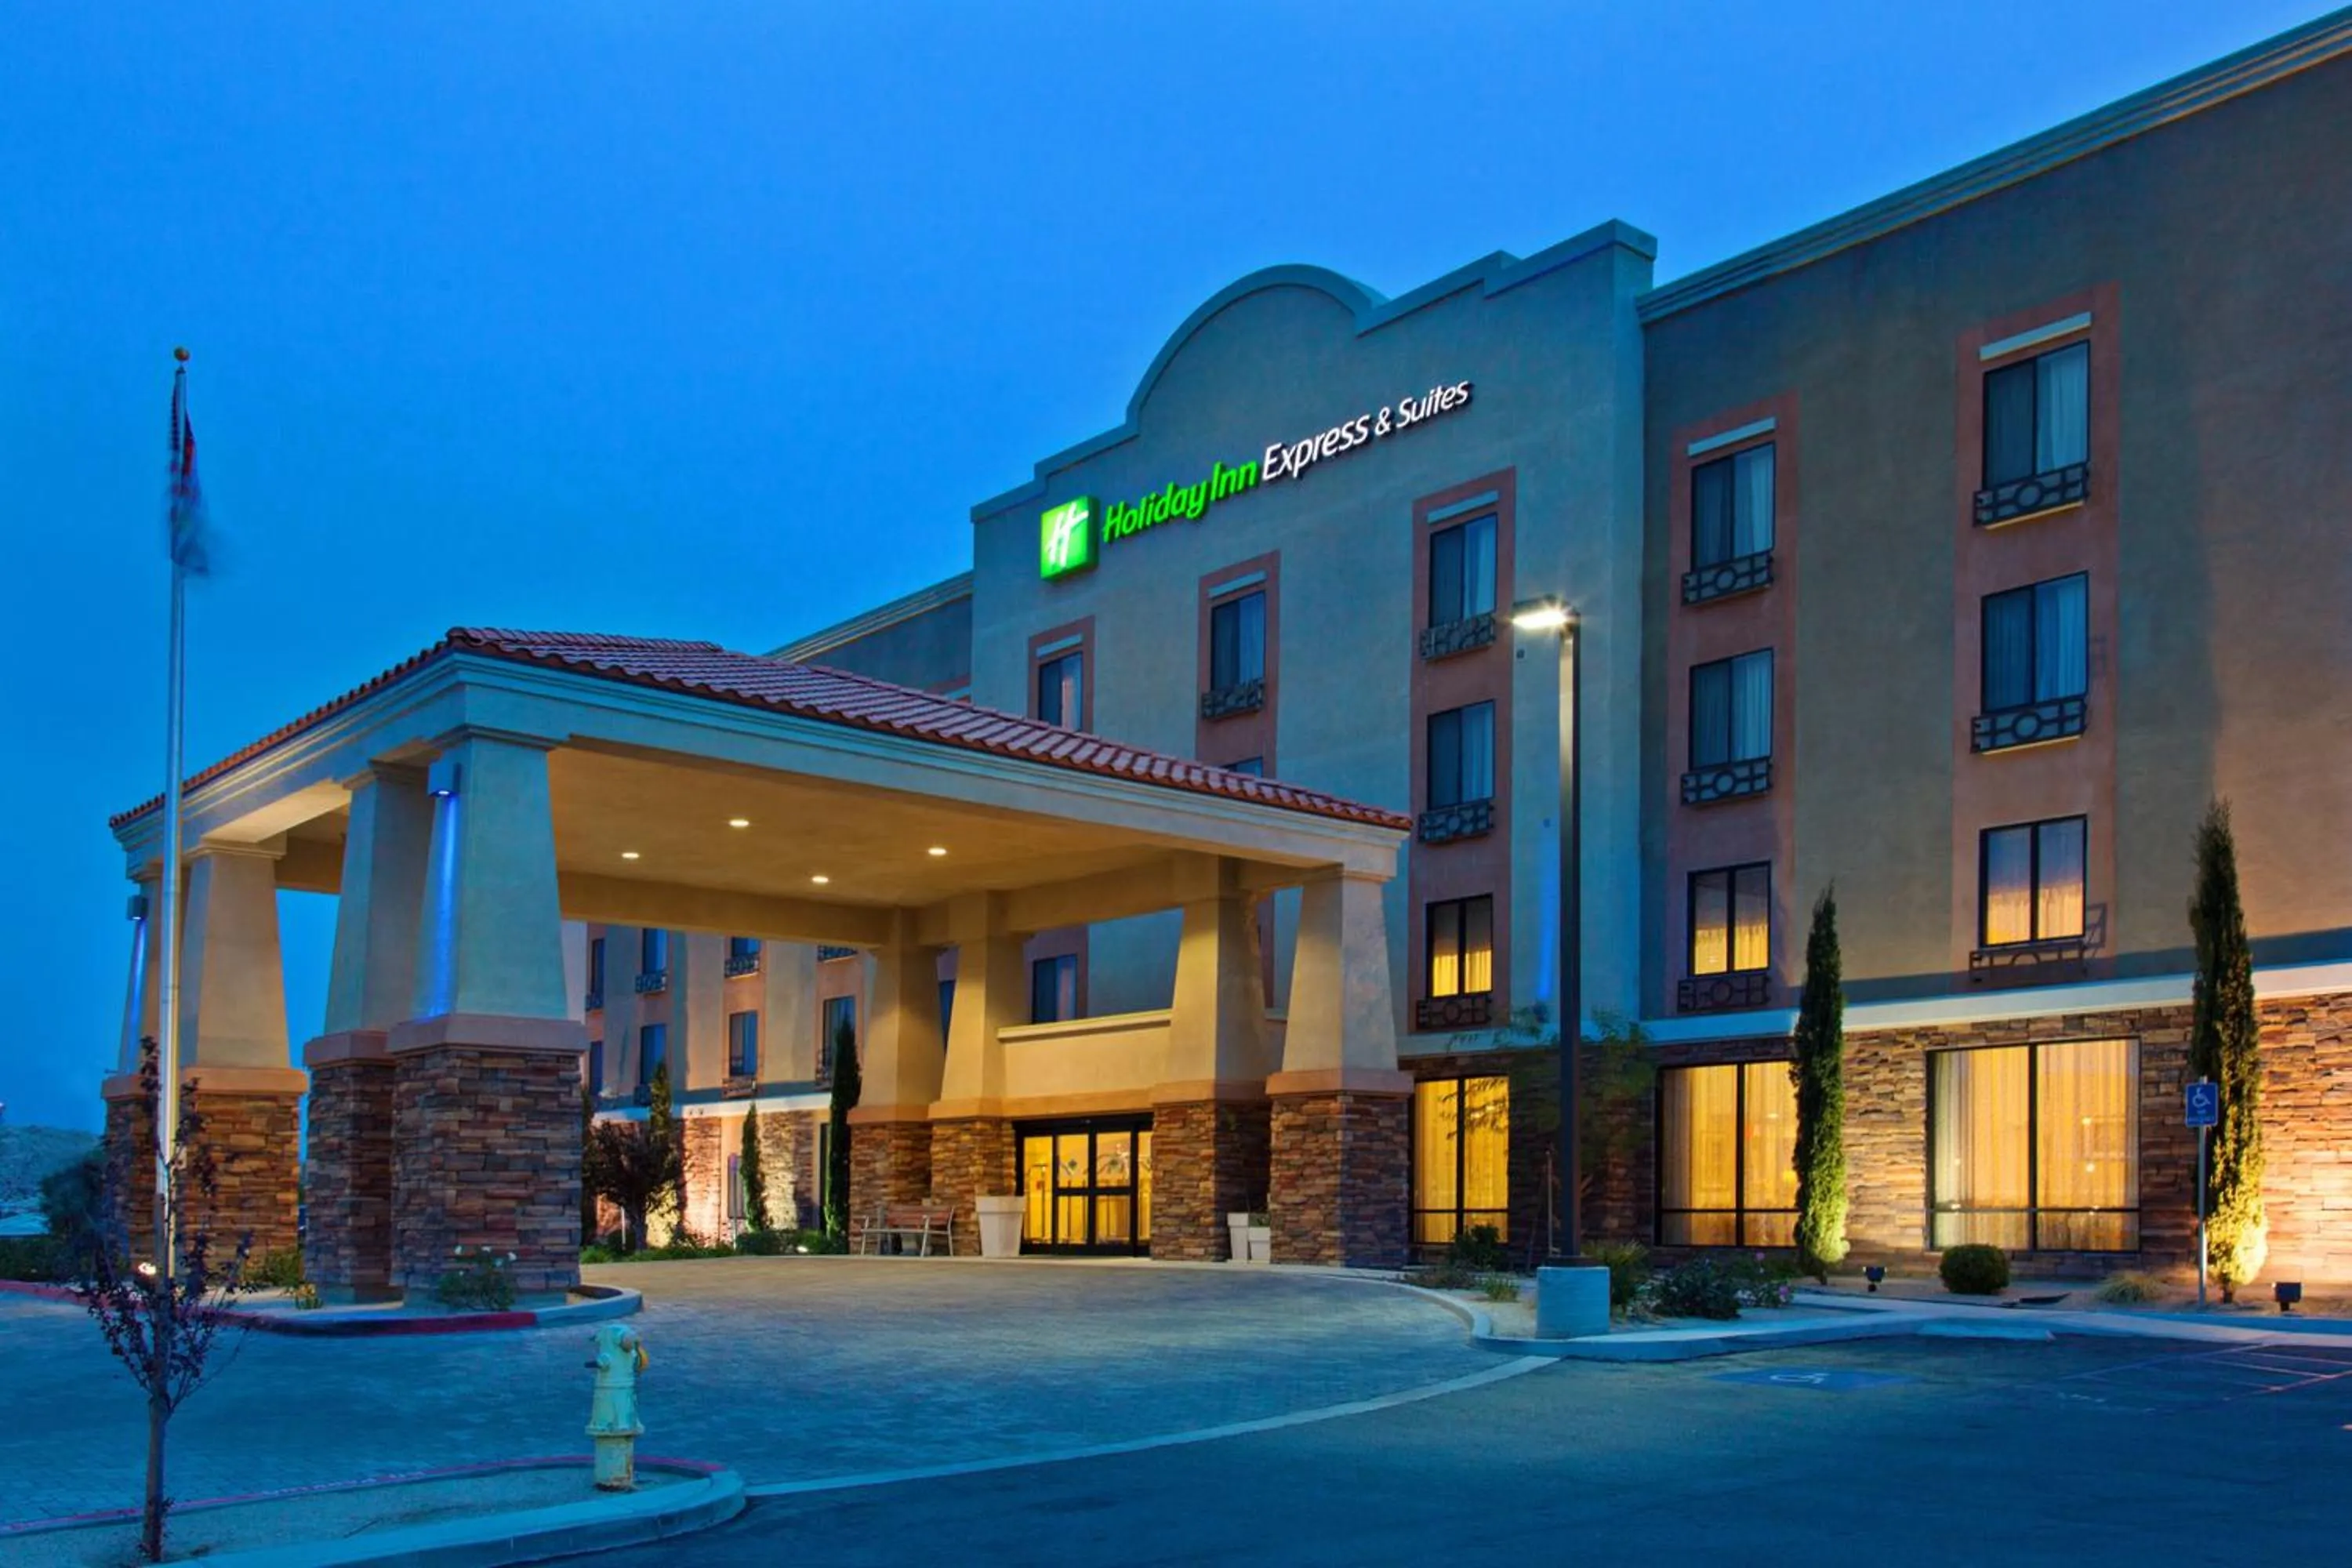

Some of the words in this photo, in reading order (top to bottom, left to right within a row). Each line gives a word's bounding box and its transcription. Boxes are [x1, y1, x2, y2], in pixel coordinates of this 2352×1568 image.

[1102, 480, 1208, 543] Holiday
[1210, 460, 1258, 503] Inn
[1261, 414, 1370, 481] Express
[1374, 406, 1392, 436] &
[1396, 380, 1469, 429] Suites
